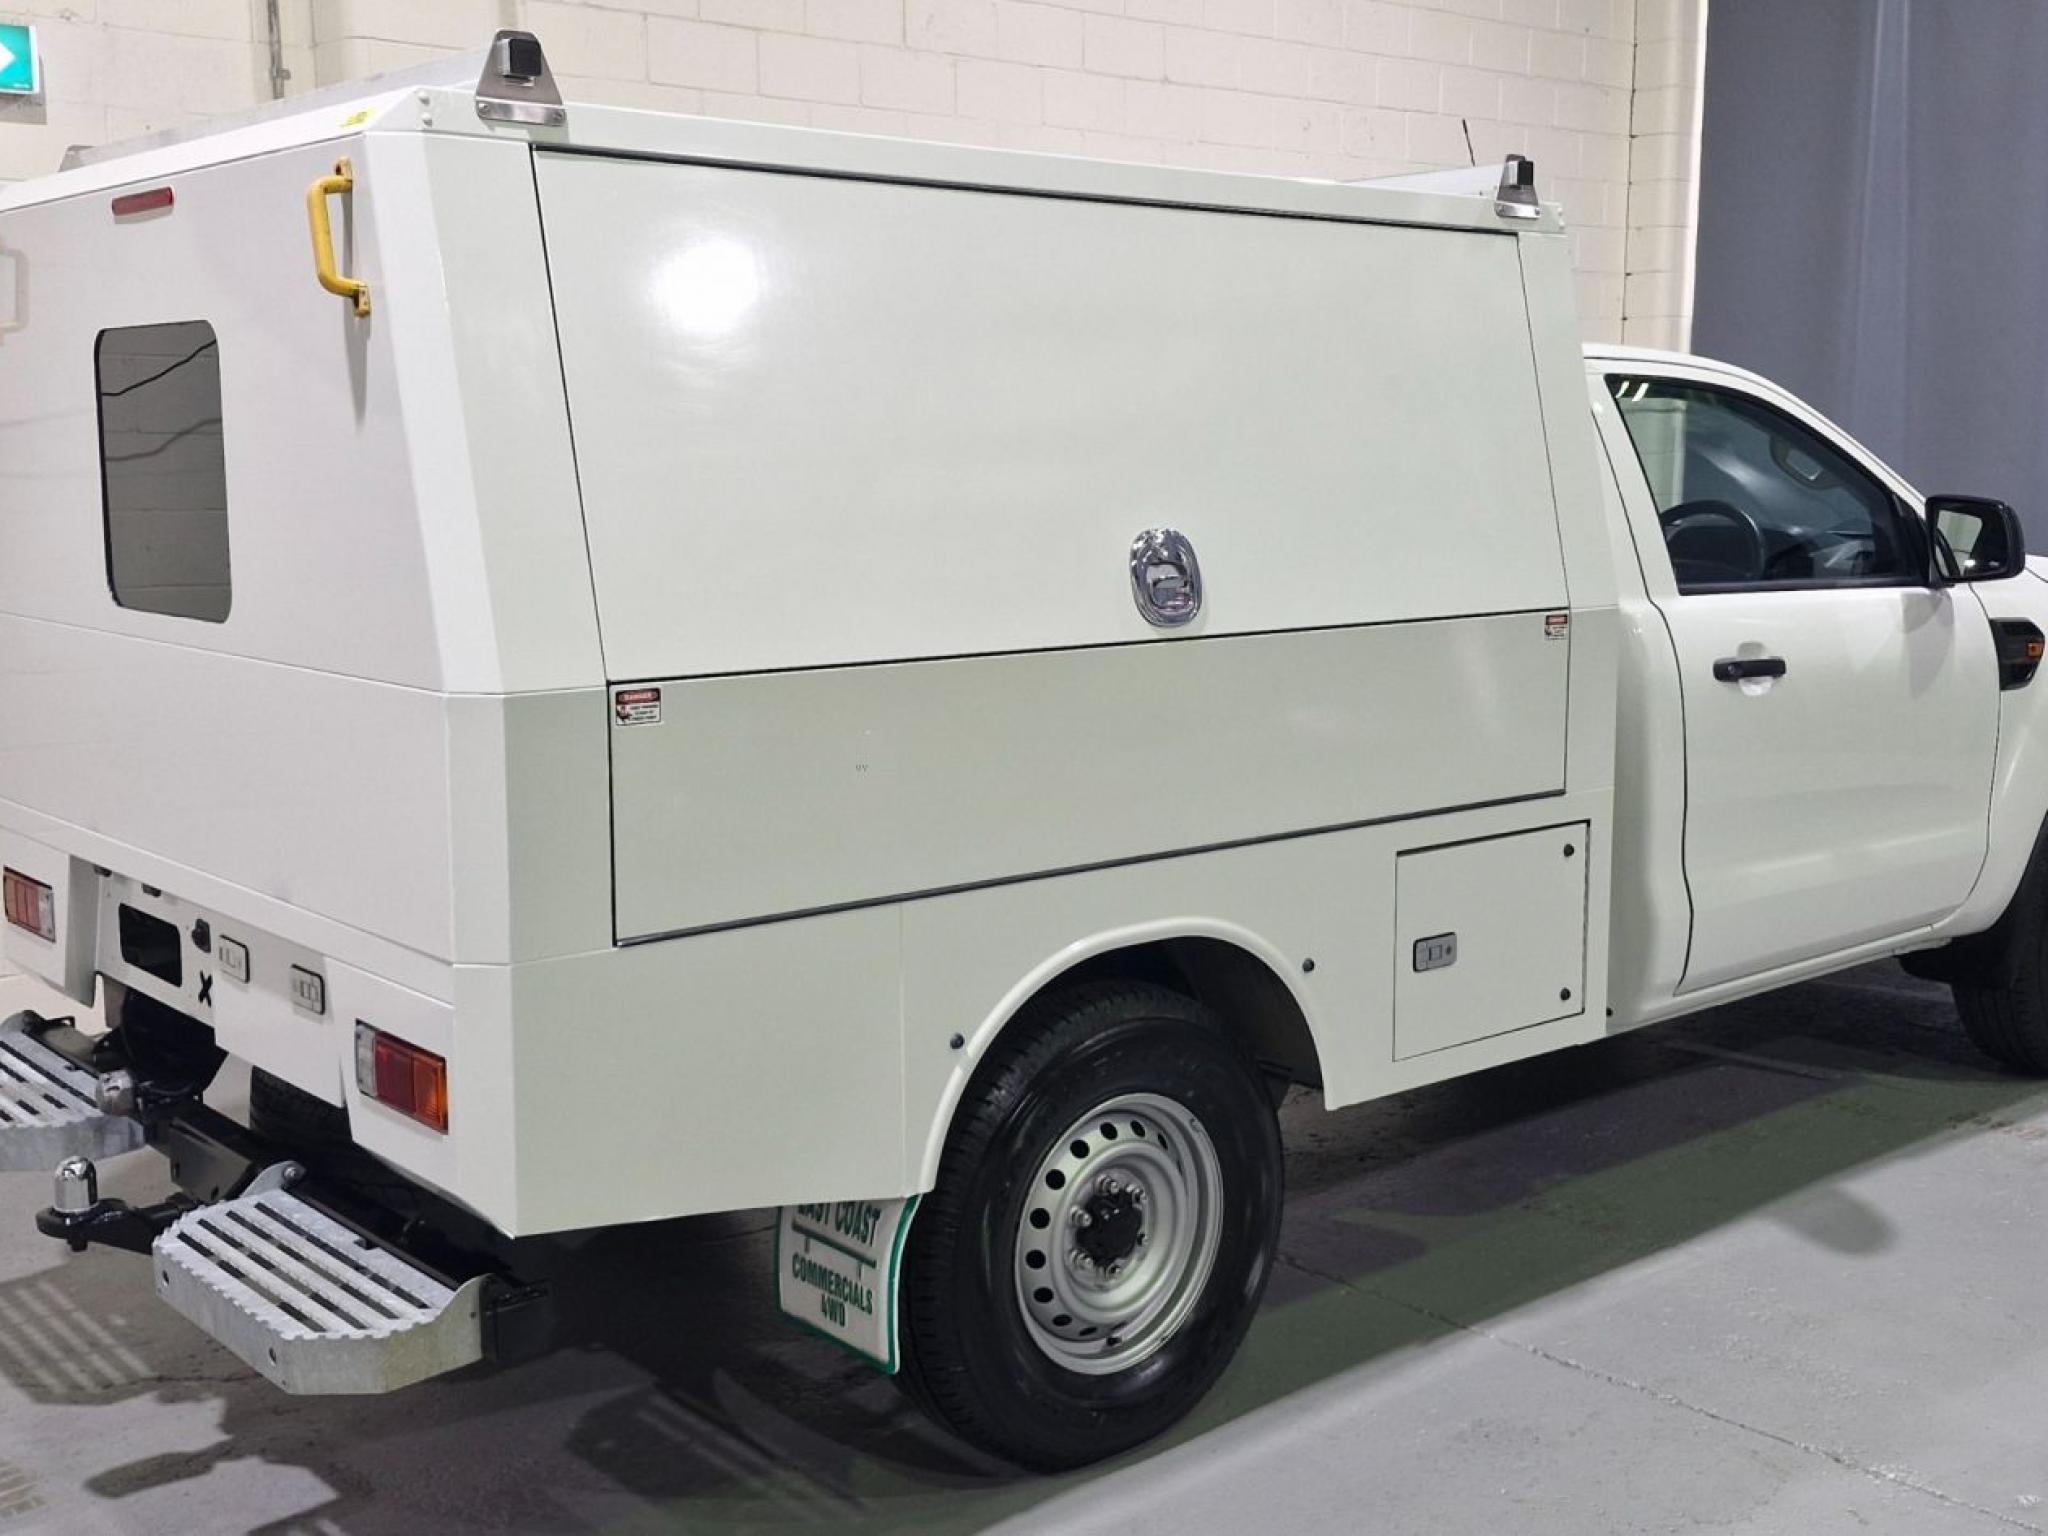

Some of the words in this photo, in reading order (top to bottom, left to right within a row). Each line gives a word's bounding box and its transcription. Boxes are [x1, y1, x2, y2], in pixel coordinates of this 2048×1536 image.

[797, 1203, 830, 1225] ST
[835, 1200, 881, 1247] COAST
[792, 1253, 873, 1315] COMMERCIALS
[821, 1293, 845, 1327] 4WD
